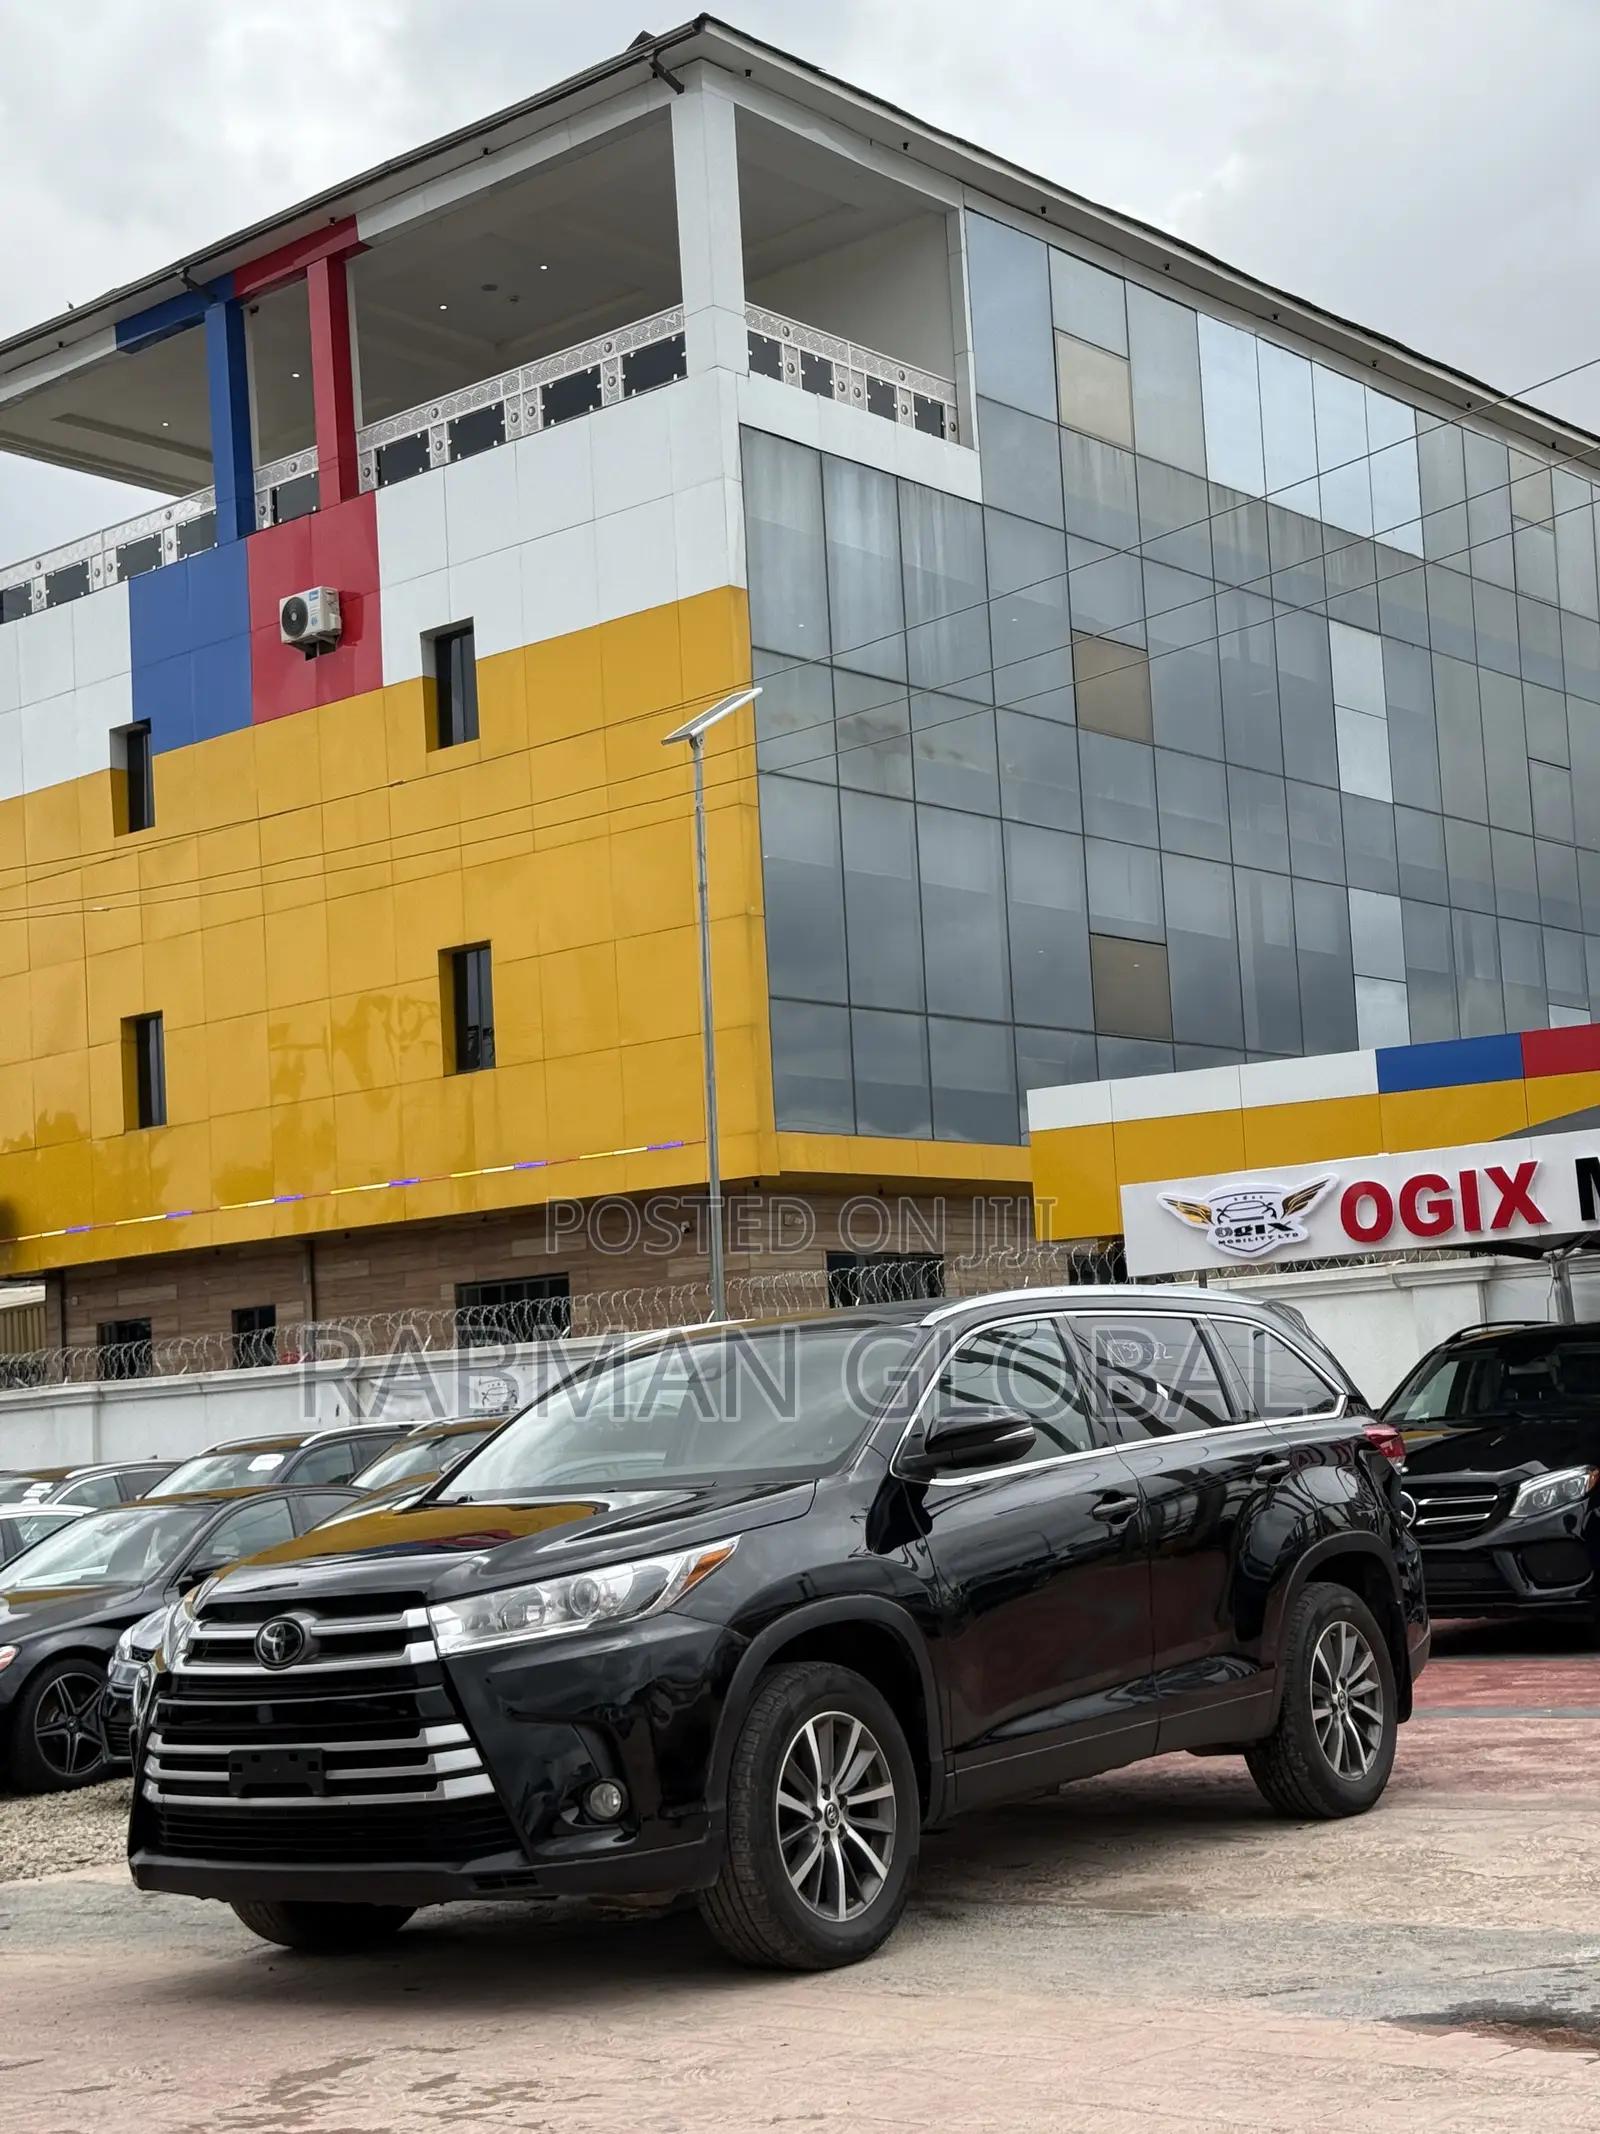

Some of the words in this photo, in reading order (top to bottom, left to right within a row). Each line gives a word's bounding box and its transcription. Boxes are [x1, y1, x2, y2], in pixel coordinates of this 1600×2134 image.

[1340, 1161, 1549, 1243] OGIX
[1218, 1234, 1274, 1245] MOBILITY
[1278, 1232, 1299, 1240] LTD
